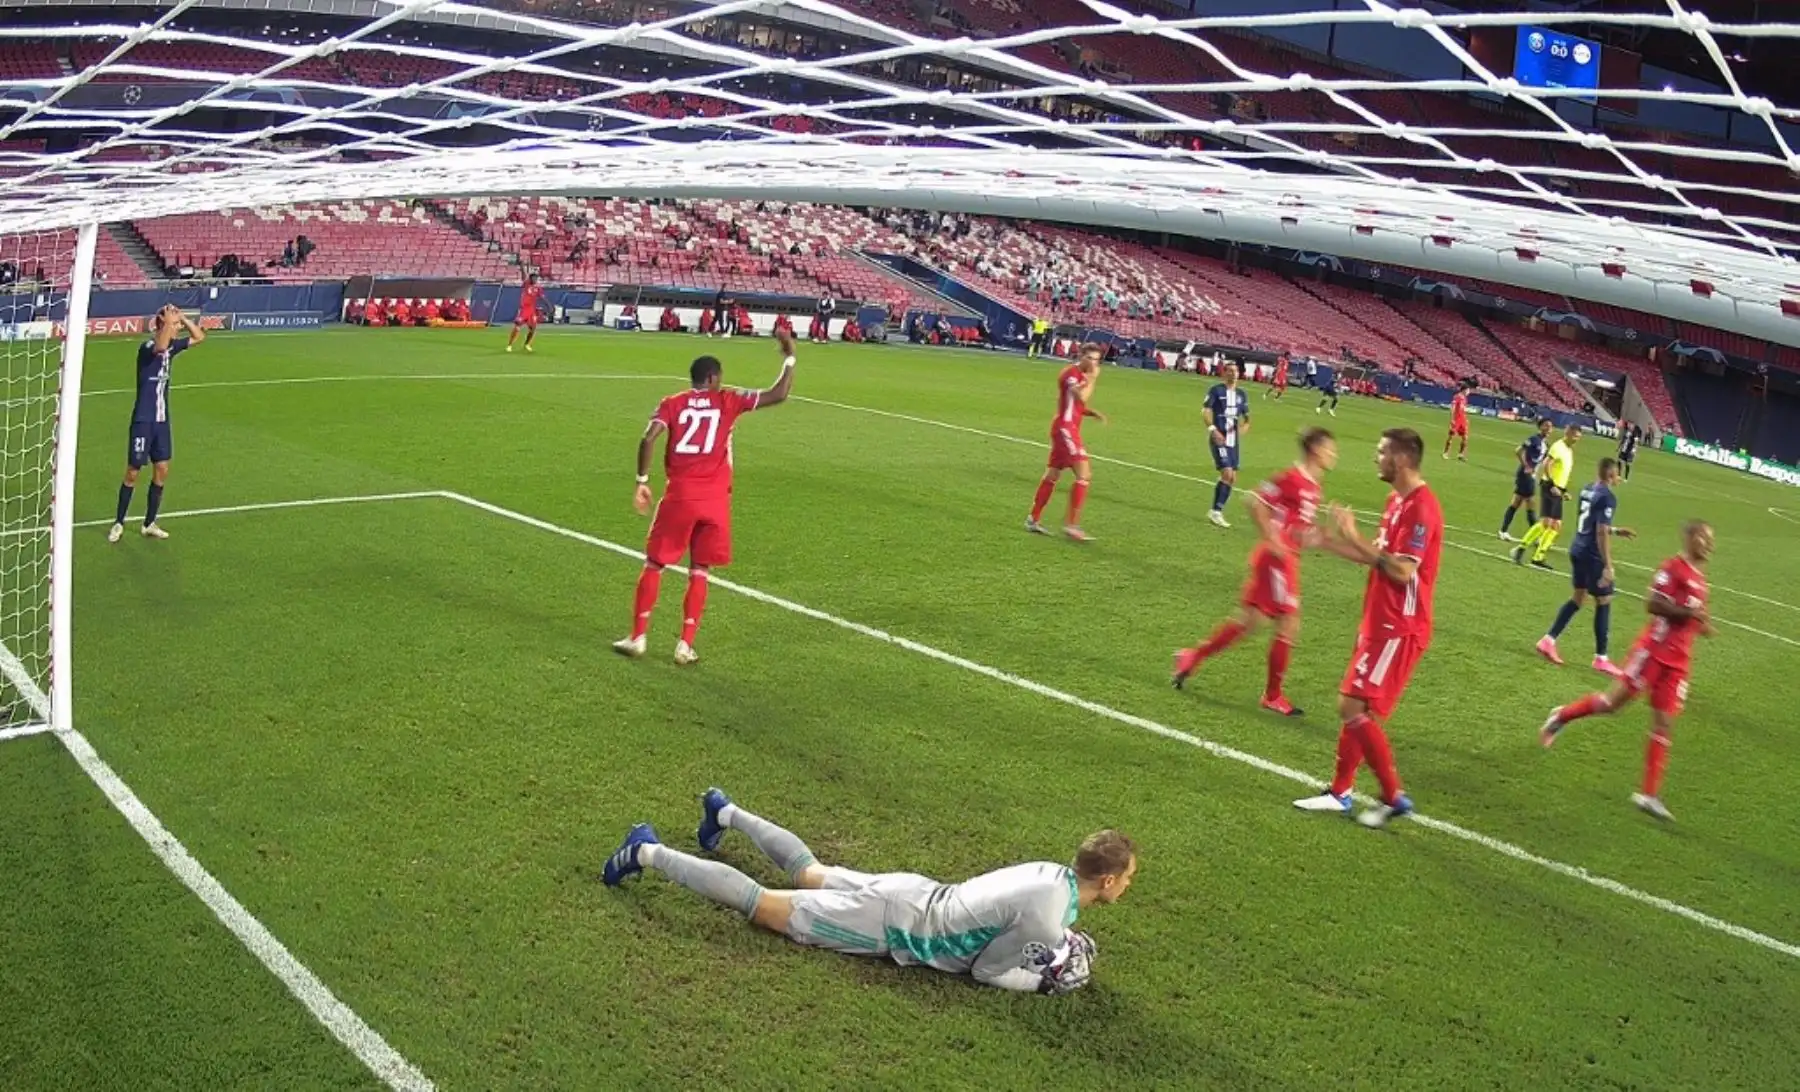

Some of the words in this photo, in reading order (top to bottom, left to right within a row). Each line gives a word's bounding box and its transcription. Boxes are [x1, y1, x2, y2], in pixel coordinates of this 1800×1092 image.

[55, 319, 138, 337] NSSAN
[238, 318, 261, 327] FINAL
[264, 317, 285, 326] 2020
[287, 317, 319, 326] LISBON
[675, 408, 721, 454] 27
[1675, 436, 1748, 471] Socialise
[1578, 500, 1592, 533] 7
[1355, 652, 1370, 676] 4
